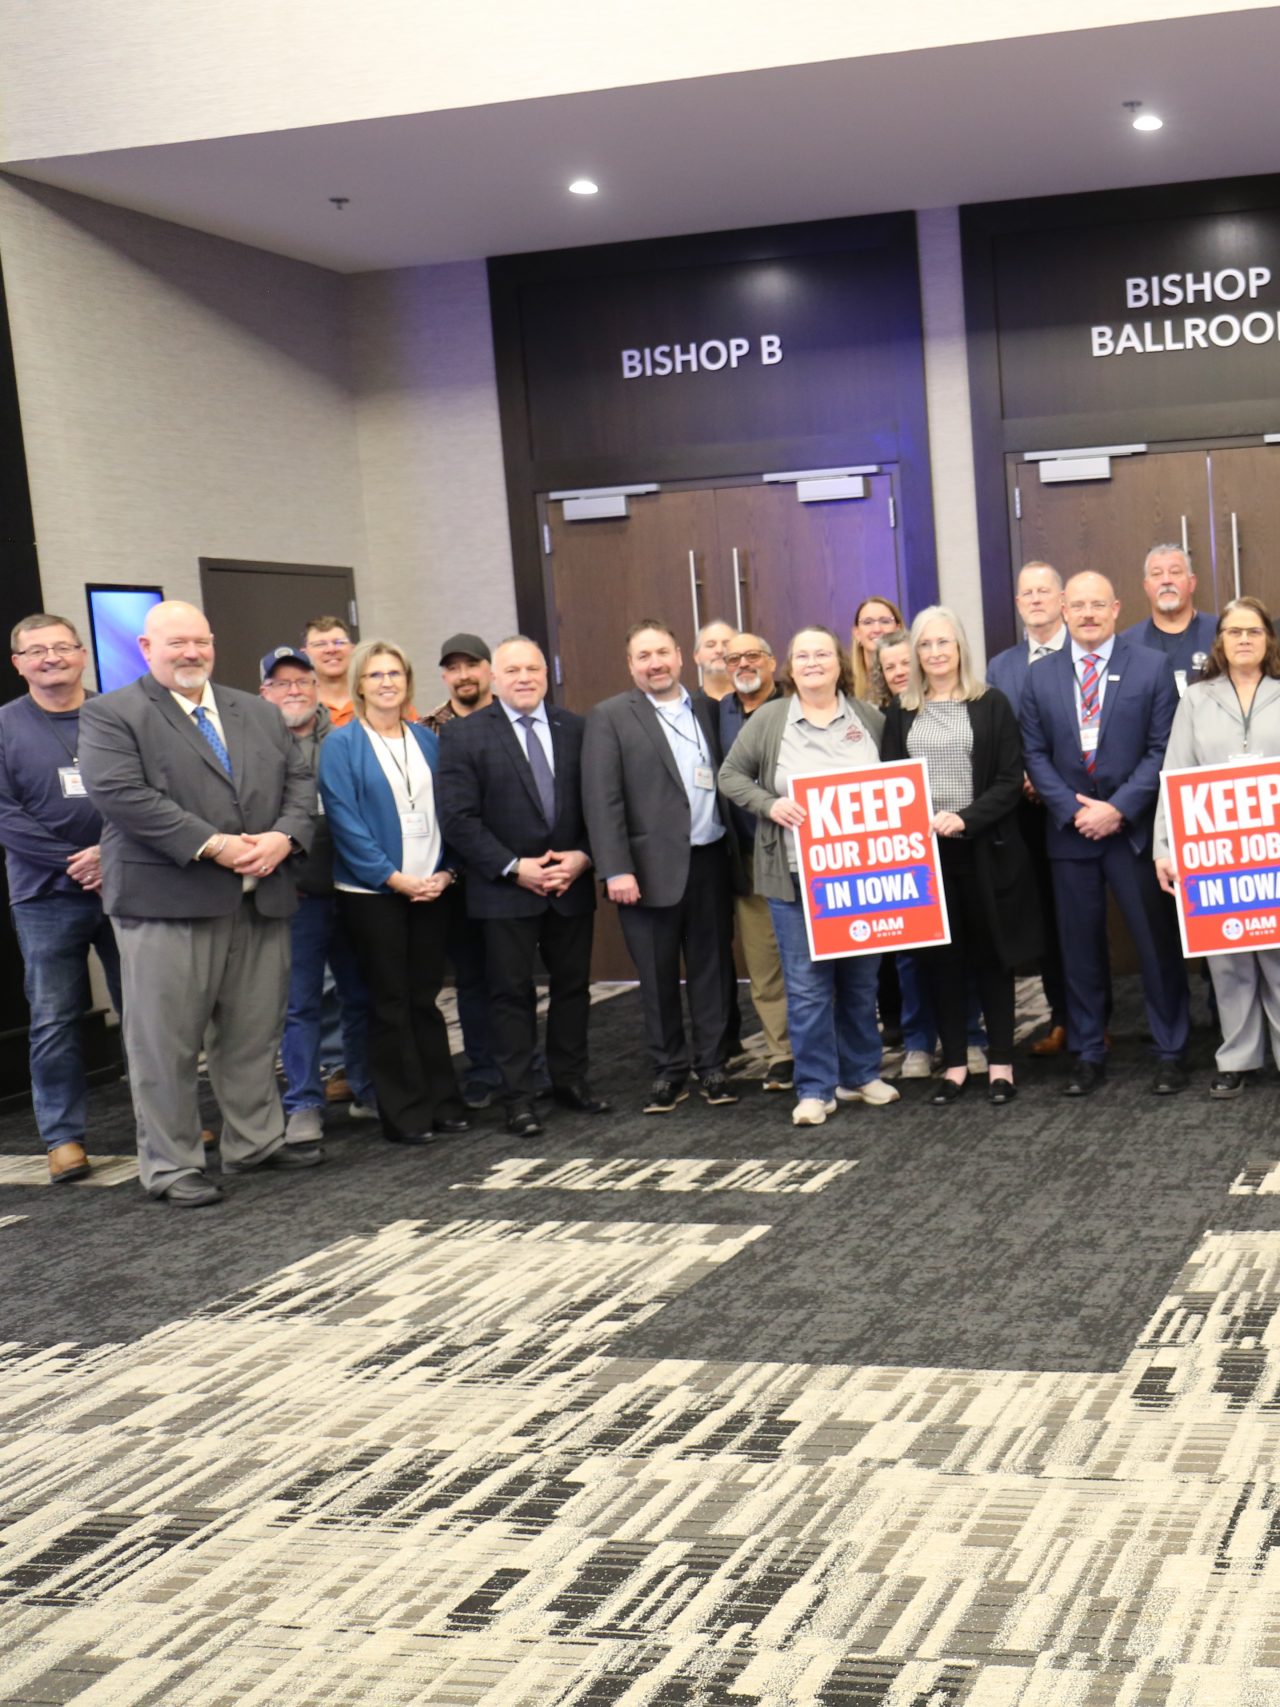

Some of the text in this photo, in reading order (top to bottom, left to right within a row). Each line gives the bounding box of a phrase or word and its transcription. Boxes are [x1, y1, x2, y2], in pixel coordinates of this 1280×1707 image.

[1125, 267, 1272, 309] BISHOP
[621, 334, 783, 379] BISHOP B
[806, 776, 916, 839] KEEP
[809, 831, 926, 872] OUR JOBS
[1182, 838, 1234, 869] OUR
[825, 872, 919, 910] IN IOWA
[1199, 878, 1225, 908] IN
[872, 916, 904, 932] IAM
[1245, 915, 1277, 931] IAM
